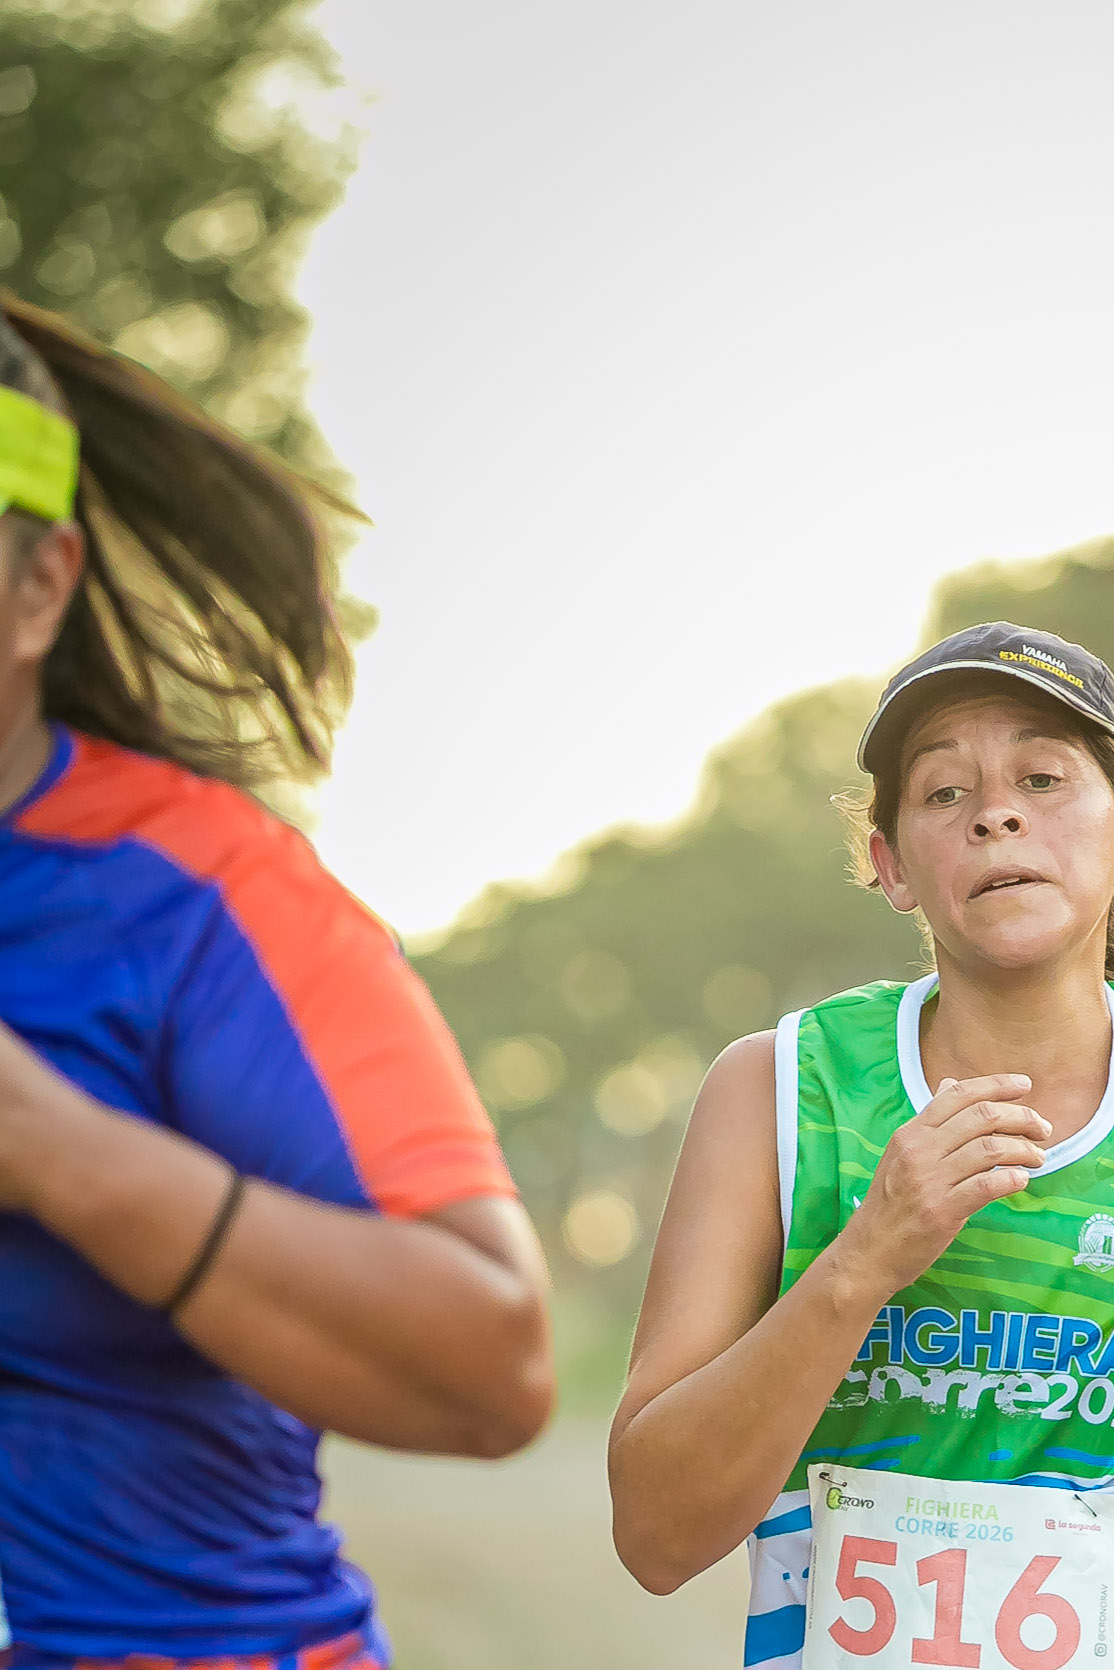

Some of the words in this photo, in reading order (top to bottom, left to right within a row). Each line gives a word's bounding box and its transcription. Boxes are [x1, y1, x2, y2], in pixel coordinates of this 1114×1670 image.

[999, 651, 1084, 689] EXPERIENCE
[1022, 644, 1068, 672] YAMAHA
[905, 1496, 999, 1521] FIGHIERA
[895, 1516, 959, 1539] CORRE
[965, 1523, 1014, 1542] 2026
